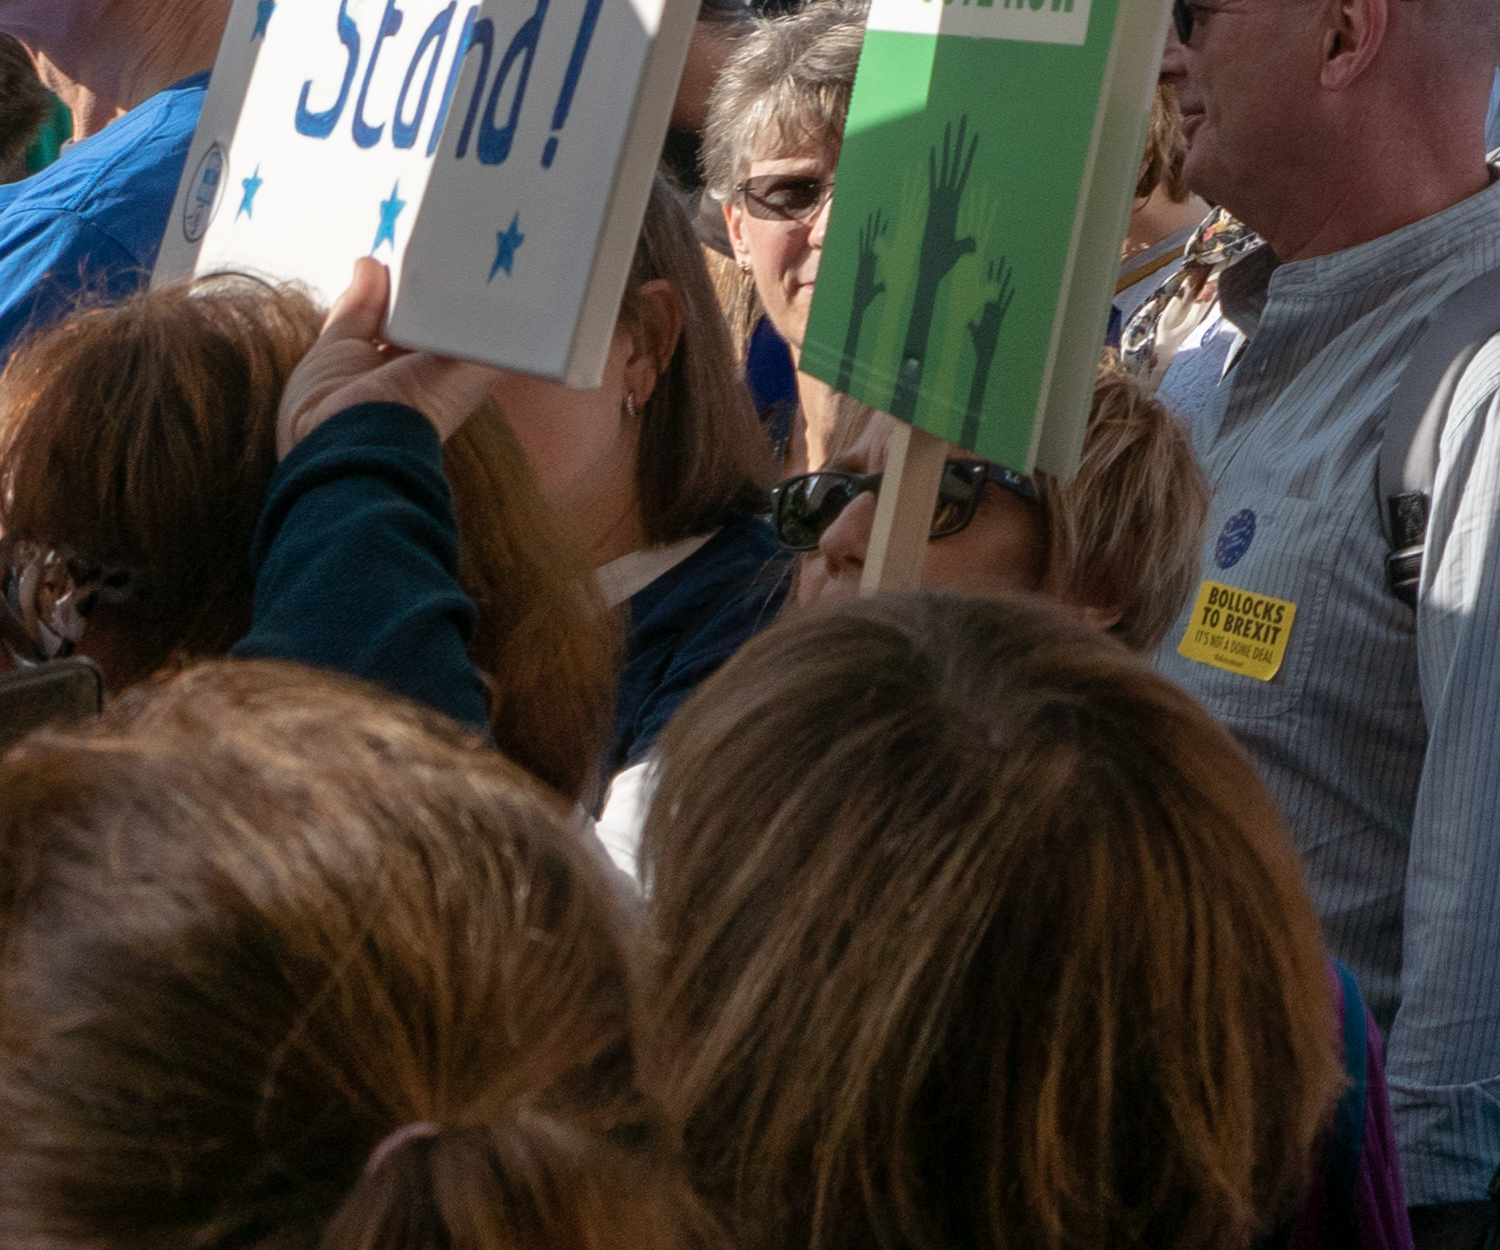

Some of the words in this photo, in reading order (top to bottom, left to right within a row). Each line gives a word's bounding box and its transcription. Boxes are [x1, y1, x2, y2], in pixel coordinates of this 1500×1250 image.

[1207, 586, 1286, 625] BOLLOCKS
[1201, 606, 1220, 628] TO
[1222, 613, 1282, 645] BREXIT
[1193, 630, 1210, 646] IT'S
[1209, 633, 1225, 649] NOT
[1222, 638, 1229, 651] A
[1229, 640, 1252, 659] DONE
[1252, 646, 1274, 665] DEAL
